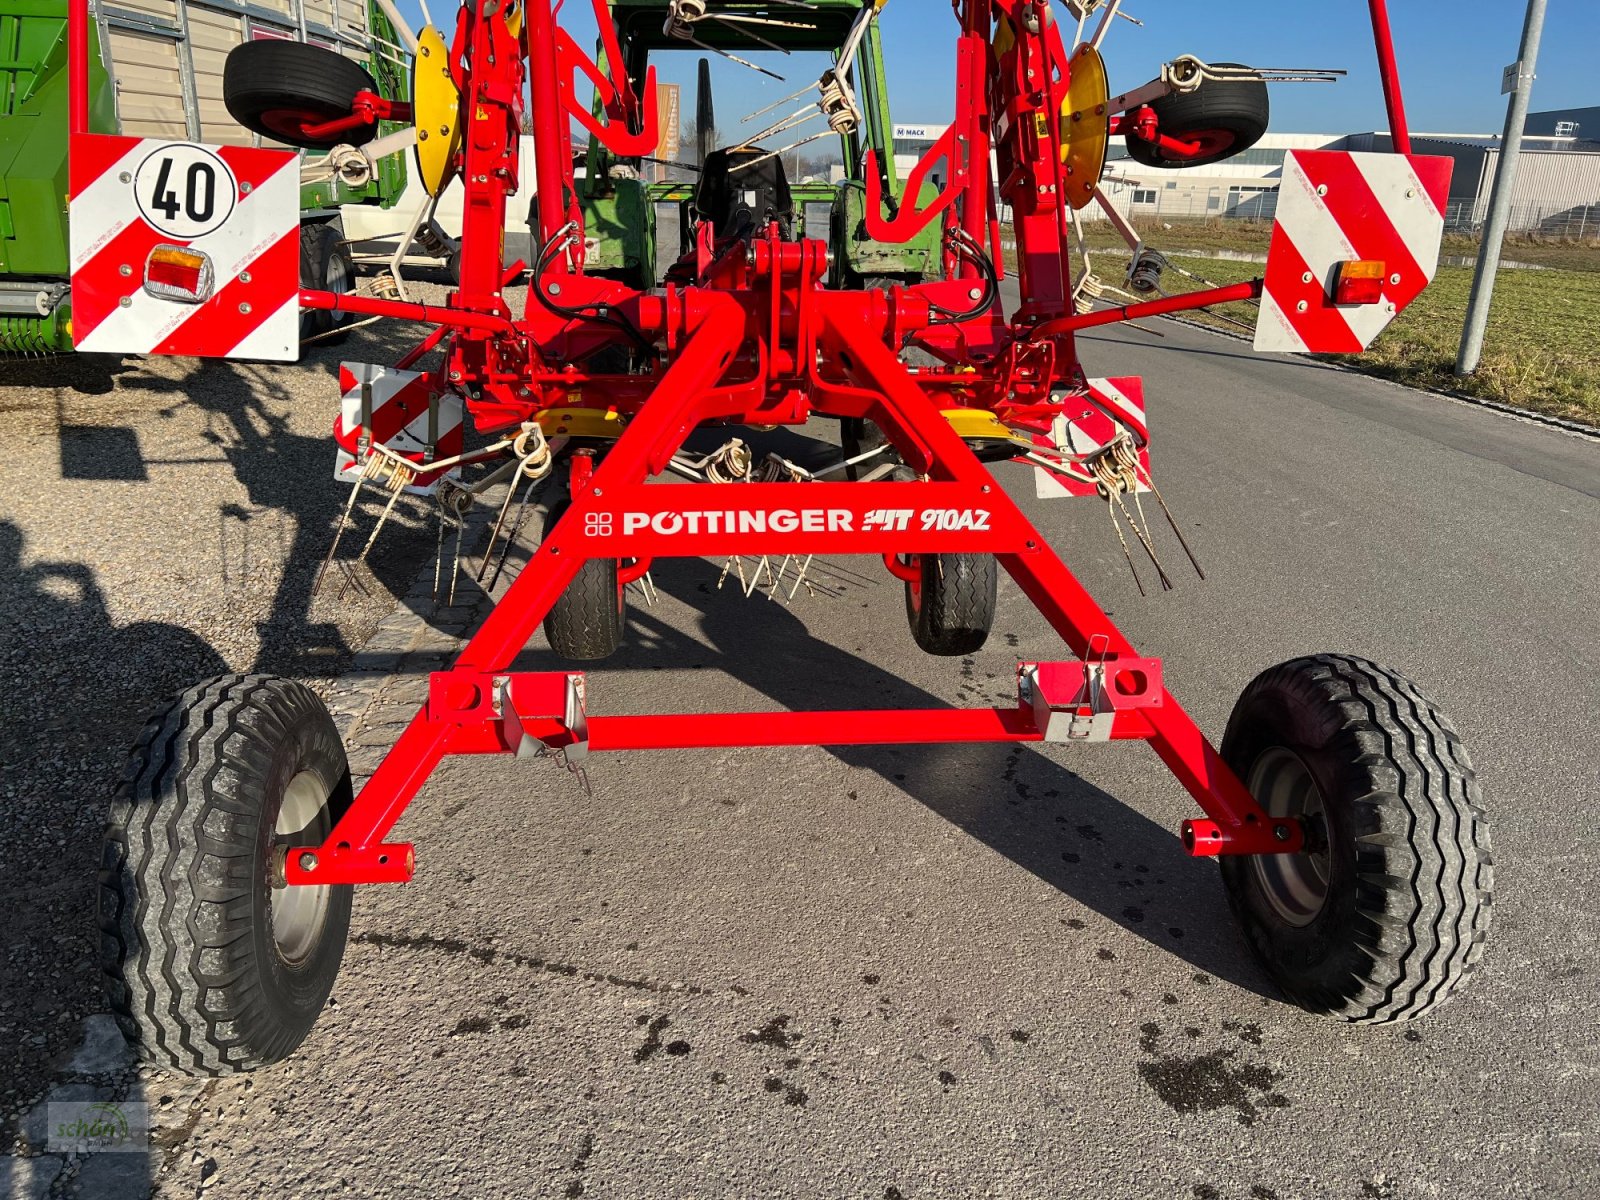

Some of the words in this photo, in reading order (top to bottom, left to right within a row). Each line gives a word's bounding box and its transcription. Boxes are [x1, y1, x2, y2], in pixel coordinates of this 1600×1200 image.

[151, 157, 216, 223] 40
[622, 508, 854, 536] PÖTTINGER
[861, 508, 915, 532] HIT
[920, 508, 991, 532] 910AZ
